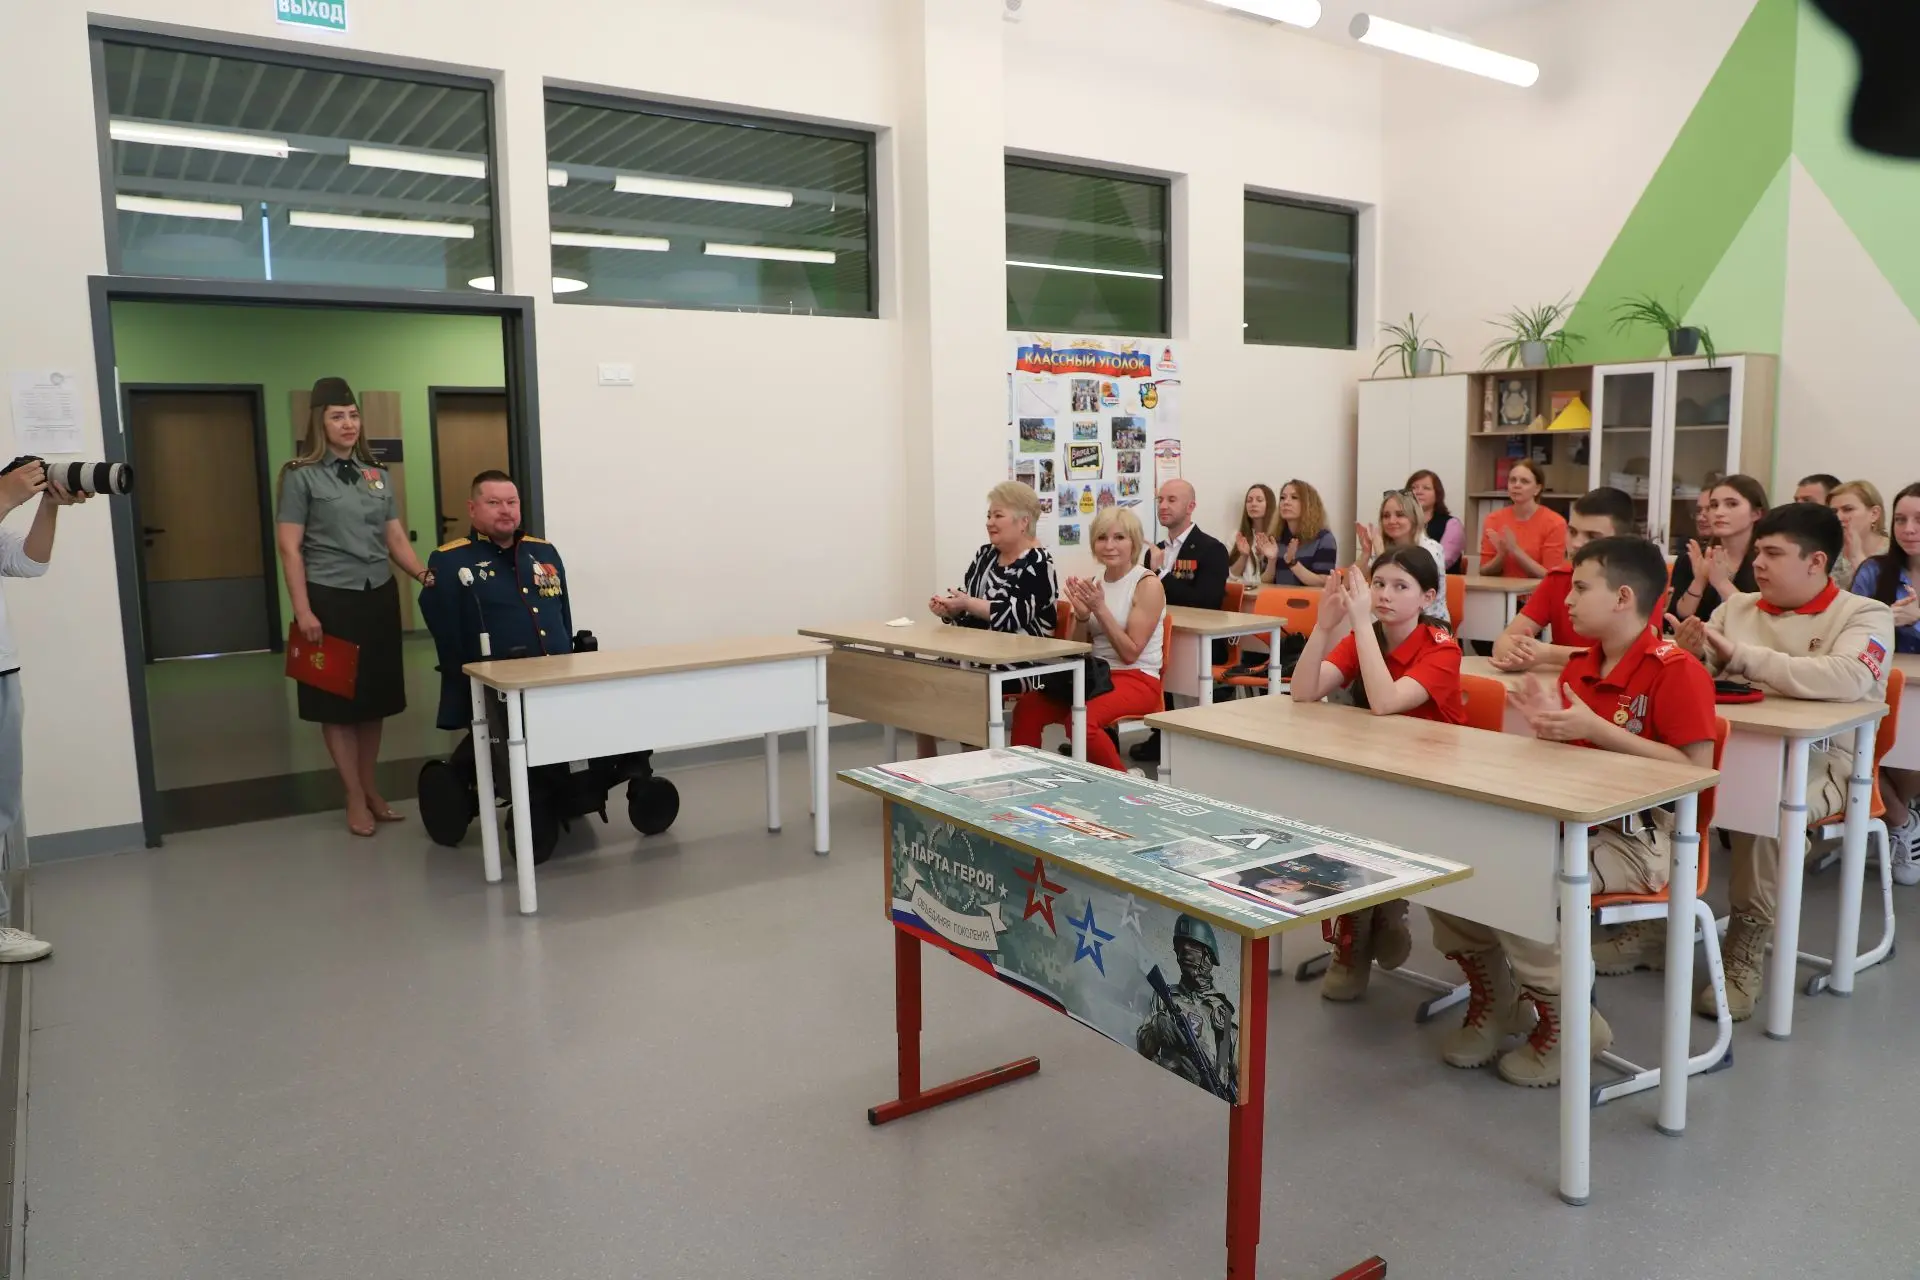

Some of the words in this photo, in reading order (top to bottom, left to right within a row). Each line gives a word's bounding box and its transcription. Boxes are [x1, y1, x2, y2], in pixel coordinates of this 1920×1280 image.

[278, 0, 344, 24] ВЫХОД
[1024, 351, 1096, 367] КЛАССНЫЙ
[1099, 356, 1146, 370] УГОЛОК
[911, 842, 950, 873] ПАРТА
[953, 861, 994, 893] ГЕРОЯ
[917, 897, 951, 929] ОБЪЕДИНЯЯ
[953, 923, 991, 941] ПОКОЛЕНИЯ
